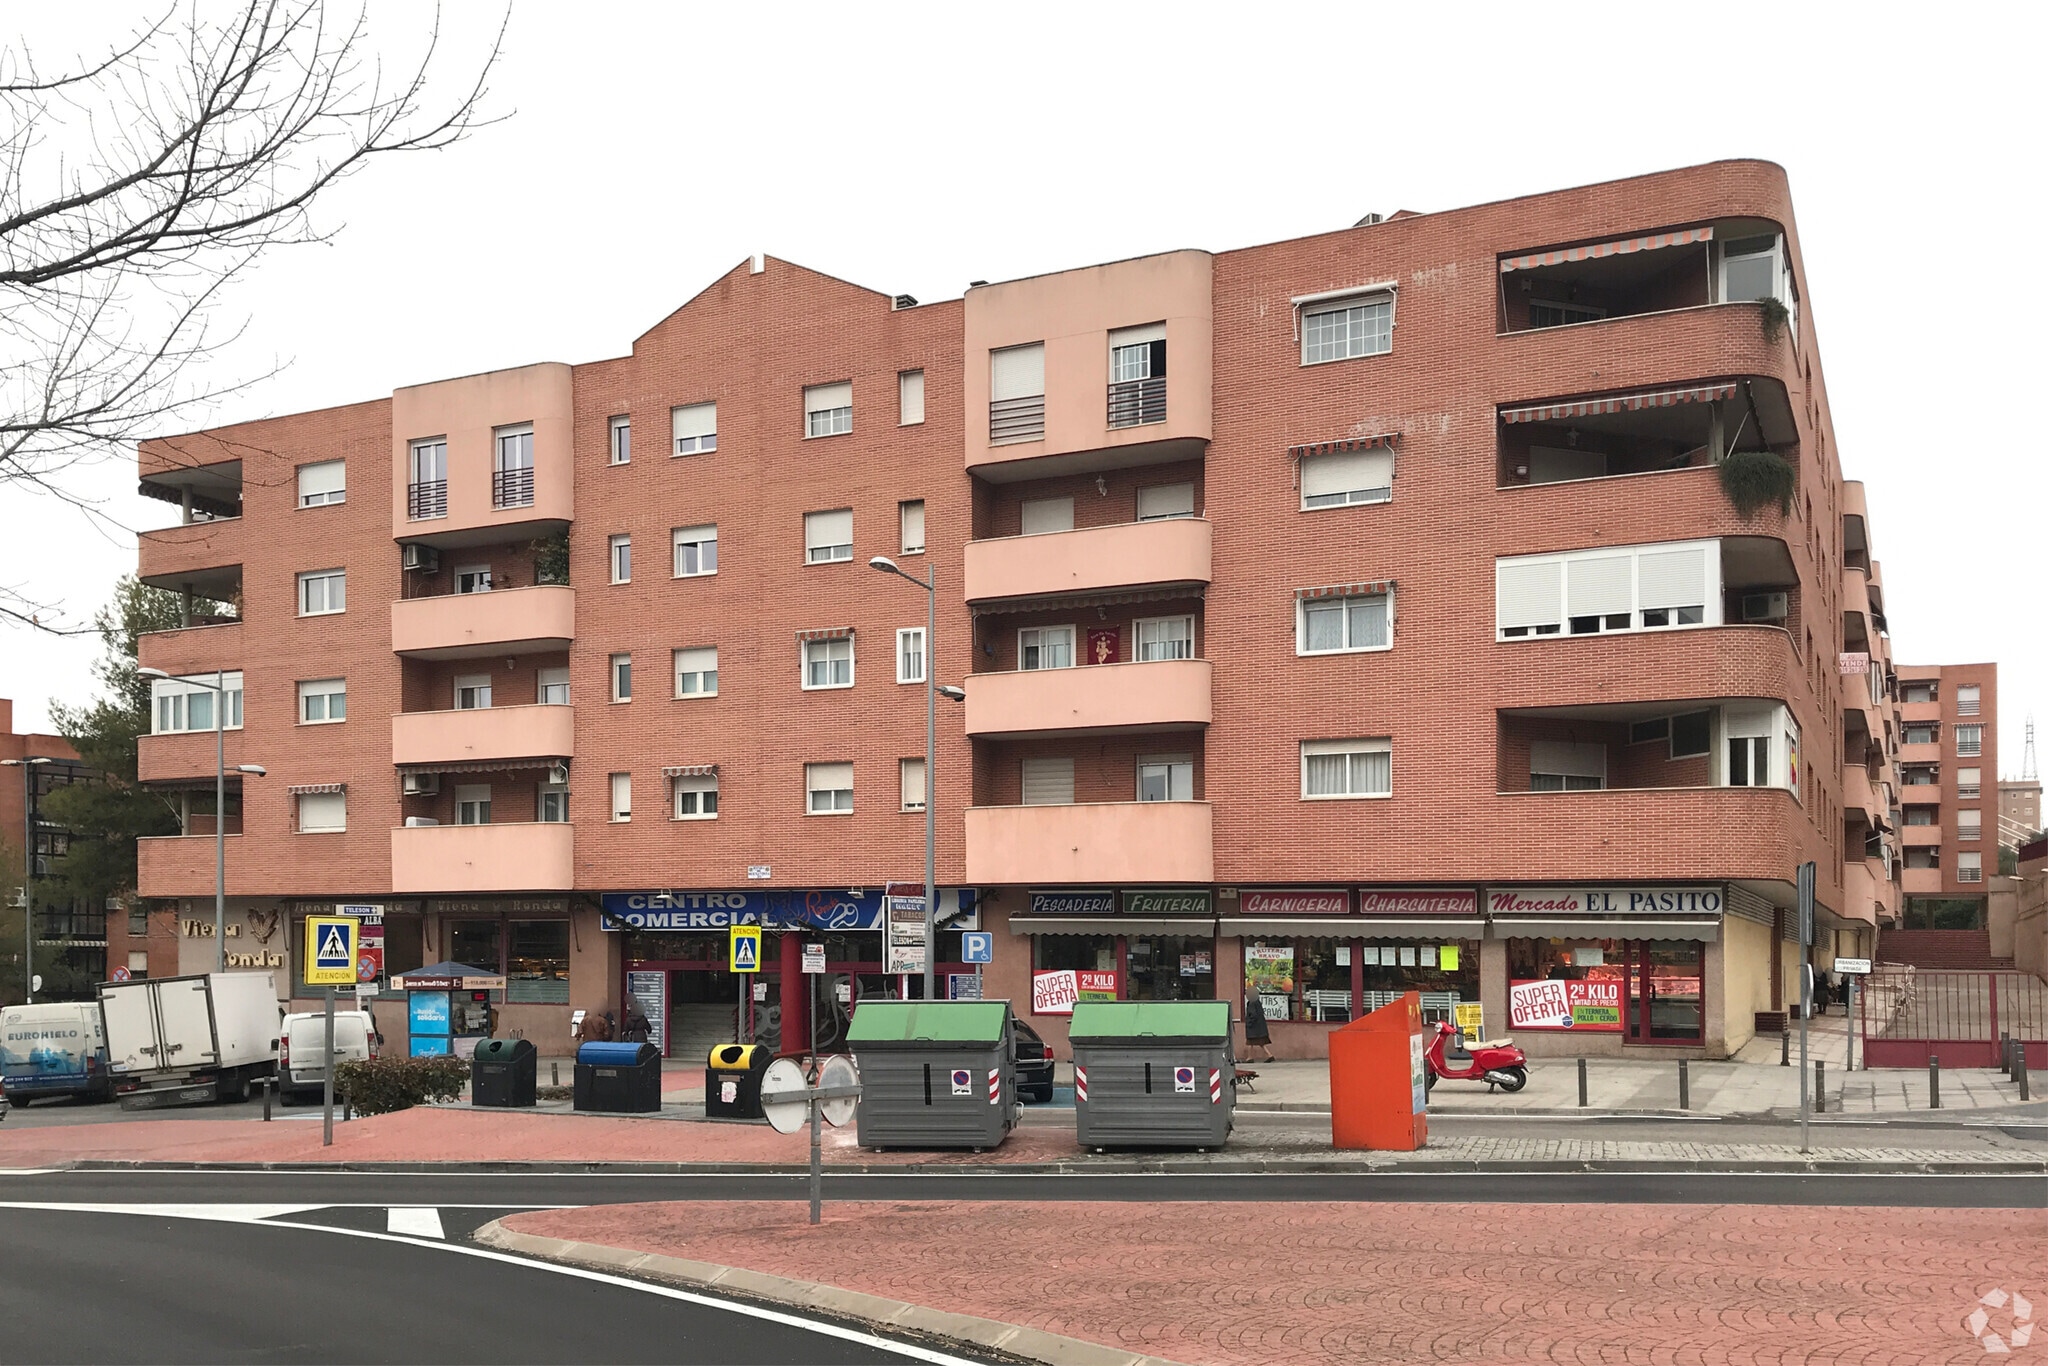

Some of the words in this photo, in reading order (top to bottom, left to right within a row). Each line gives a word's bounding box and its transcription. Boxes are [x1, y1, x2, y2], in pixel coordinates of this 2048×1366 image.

[513, 900, 562, 911] Ronda
[627, 893, 747, 909] CENTRO
[1033, 896, 1113, 911] PESCADERIA
[1131, 895, 1206, 911] FRUTERIA
[1248, 895, 1342, 911] CARNICERIA
[1364, 895, 1474, 911] CHARCUTERIA
[1491, 893, 1579, 911] Mercado
[1586, 894, 1617, 911] EL
[1629, 892, 1720, 911] PASITO
[606, 911, 778, 928] COMERCIAL
[1252, 948, 1287, 957] FRUTERIA
[1035, 974, 1073, 994] SUPER
[1094, 974, 1114, 986] KILO
[1035, 988, 1077, 1008] OFERTA
[1514, 984, 1562, 1008] SUPER
[1570, 984, 1585, 999] 2º
[1588, 984, 1617, 999] KILO
[1513, 1000, 1568, 1023] OFERTA
[8, 1030, 78, 1041] EUROHIELO
